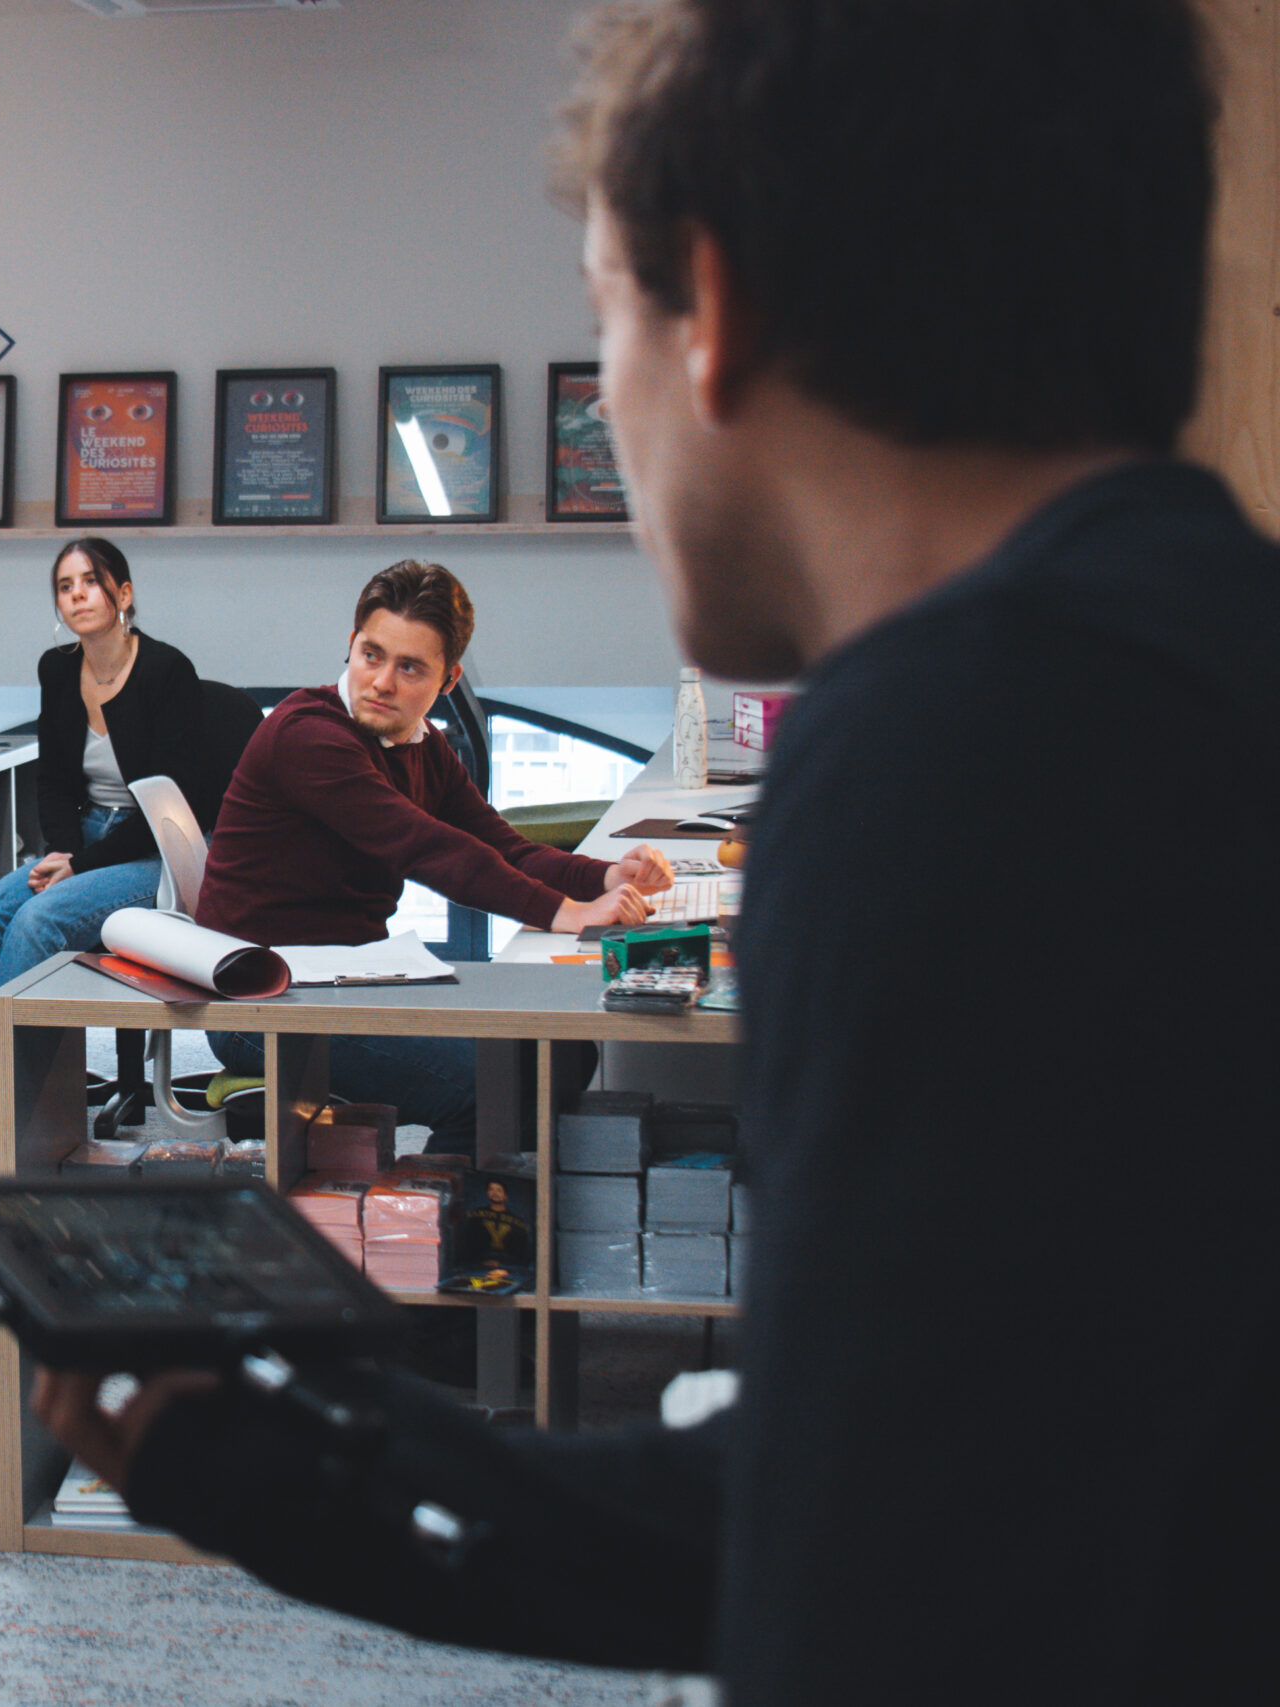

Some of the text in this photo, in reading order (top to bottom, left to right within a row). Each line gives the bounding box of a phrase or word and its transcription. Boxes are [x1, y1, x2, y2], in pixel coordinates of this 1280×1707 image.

[80, 426, 96, 438] LE
[80, 436, 146, 448] WEEKEND
[80, 447, 106, 459] DES
[80, 454, 157, 469] CURIOSITÉS
